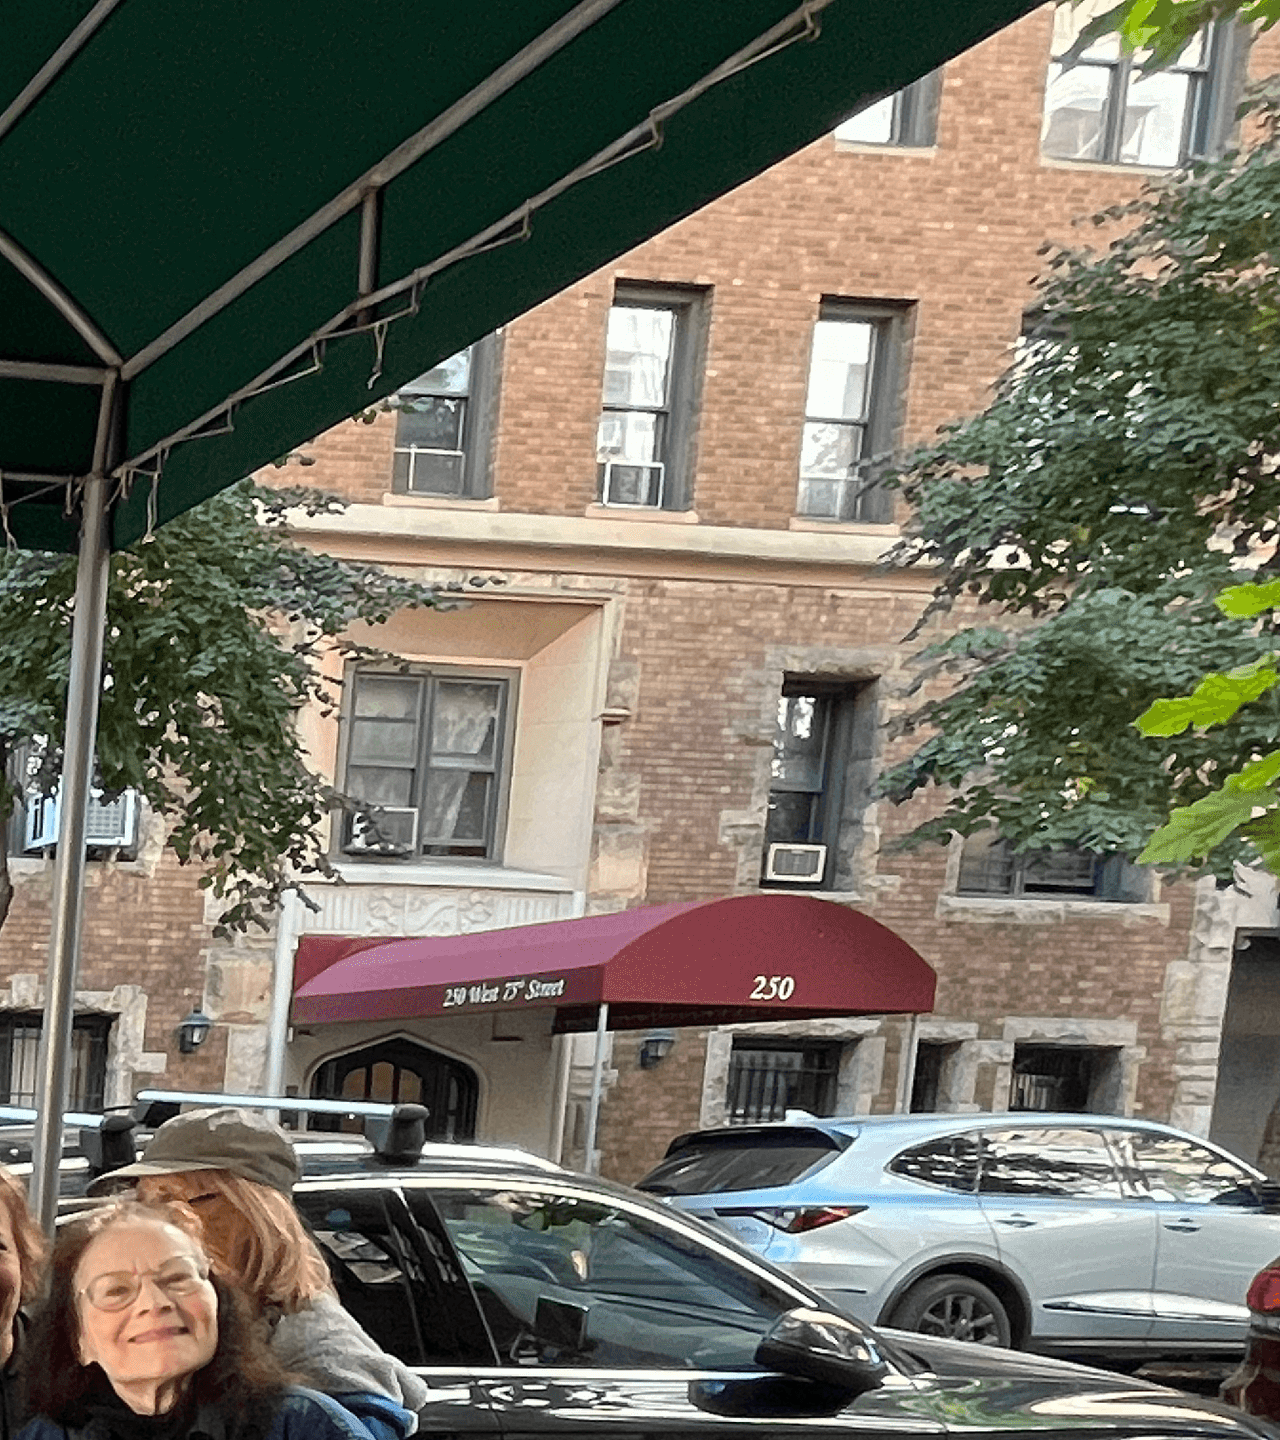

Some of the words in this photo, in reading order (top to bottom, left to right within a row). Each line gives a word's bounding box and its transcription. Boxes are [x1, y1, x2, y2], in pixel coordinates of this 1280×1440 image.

[443, 987, 467, 1008] 250
[468, 982, 499, 1004] West
[524, 979, 564, 1000] Street
[749, 975, 796, 1001] 250
